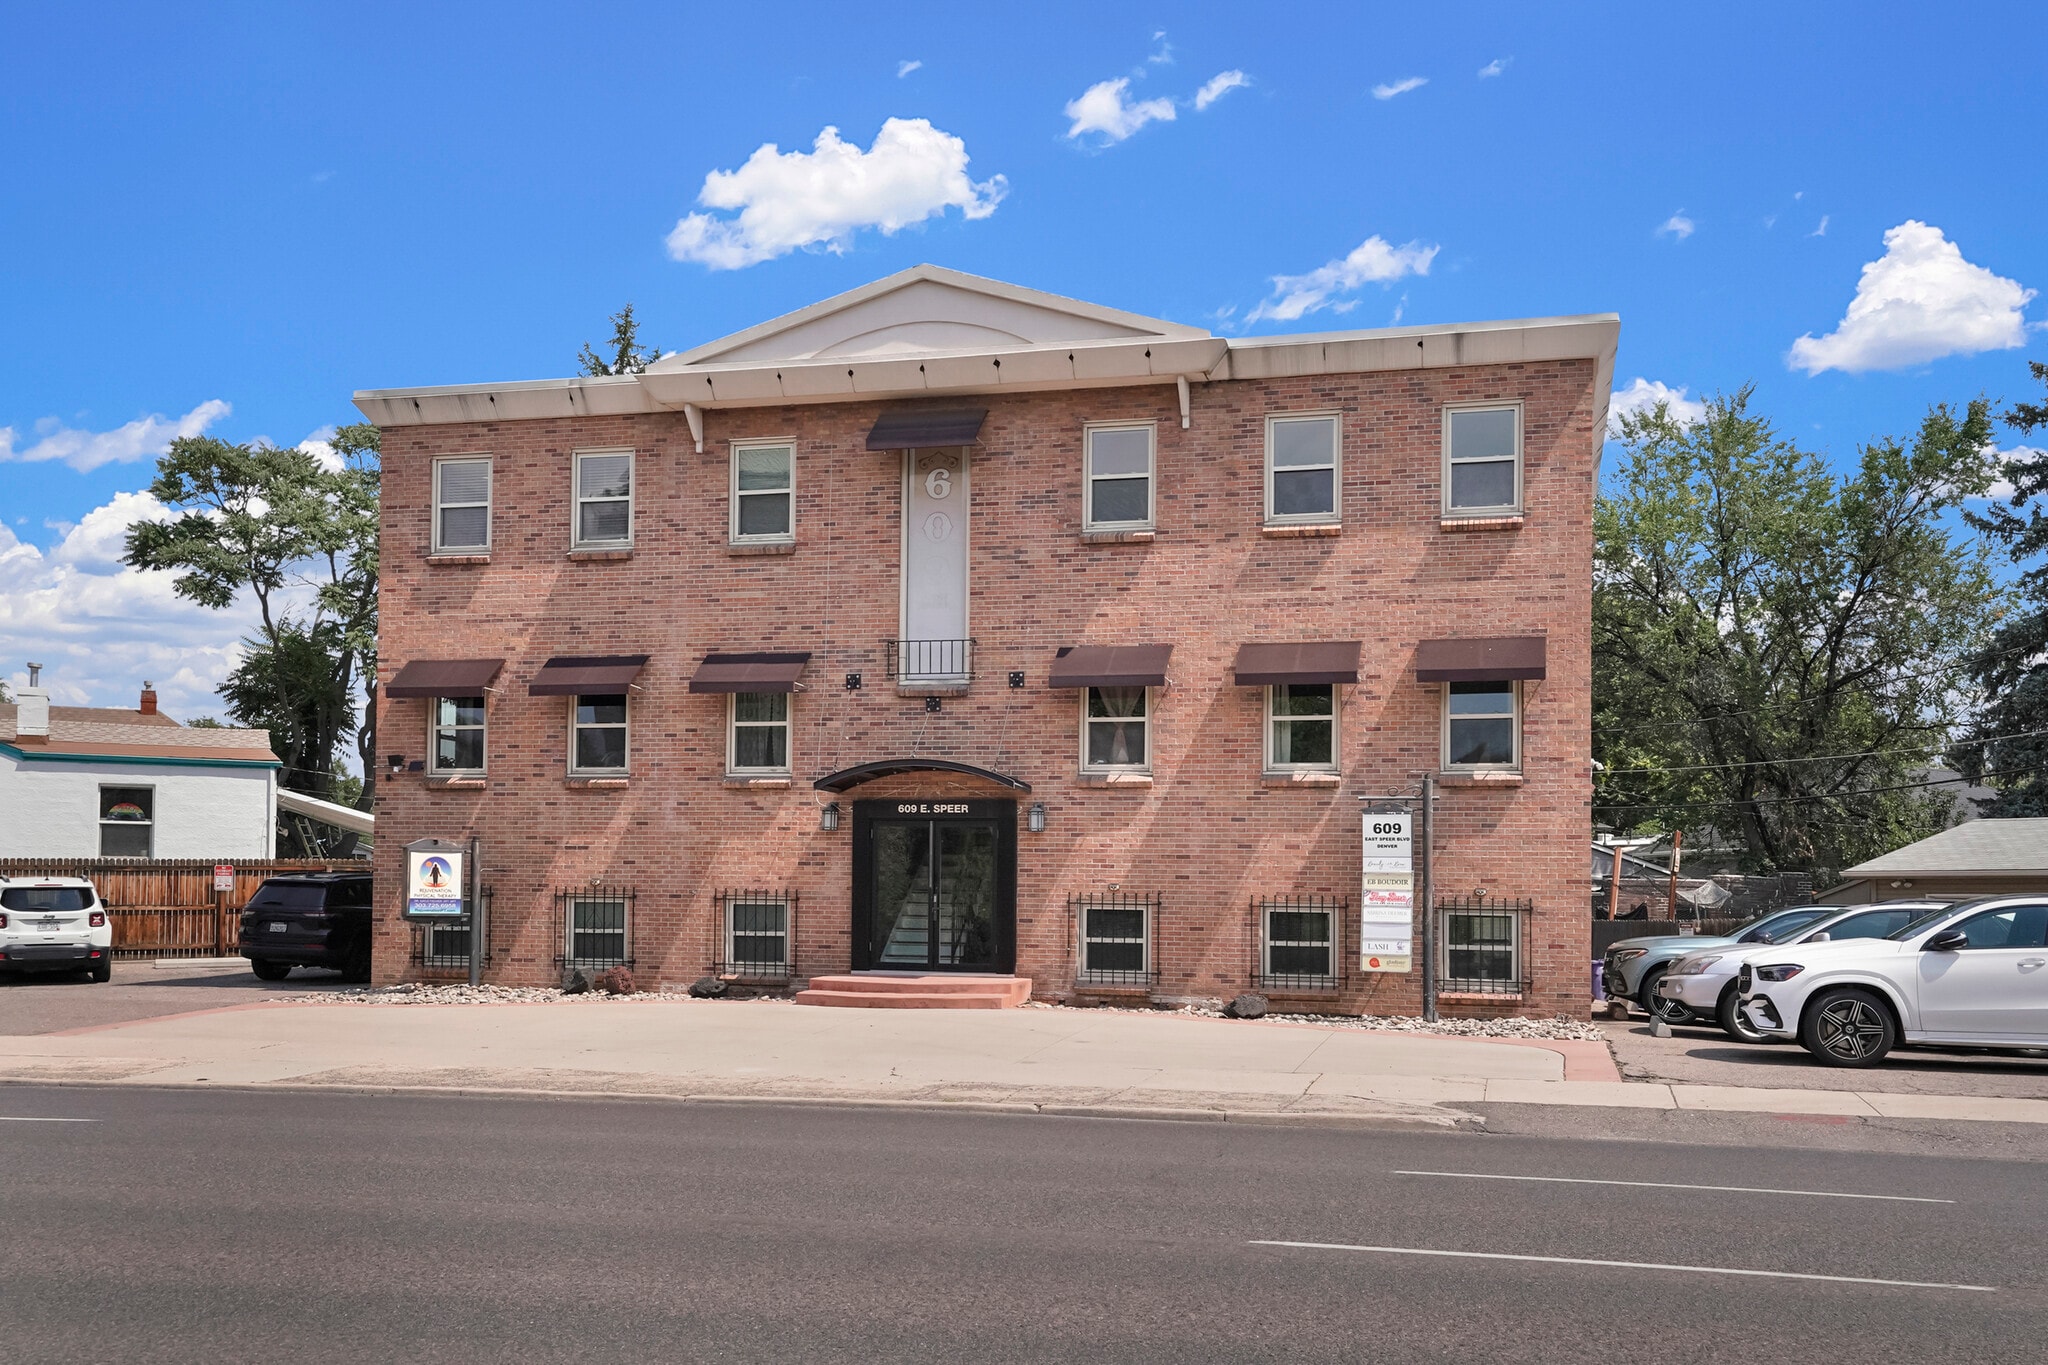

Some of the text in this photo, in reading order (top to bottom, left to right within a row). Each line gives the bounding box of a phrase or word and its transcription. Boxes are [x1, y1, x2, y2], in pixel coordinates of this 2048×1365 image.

[898, 804, 969, 813] 609 E. SPEER
[1373, 823, 1402, 834] 609
